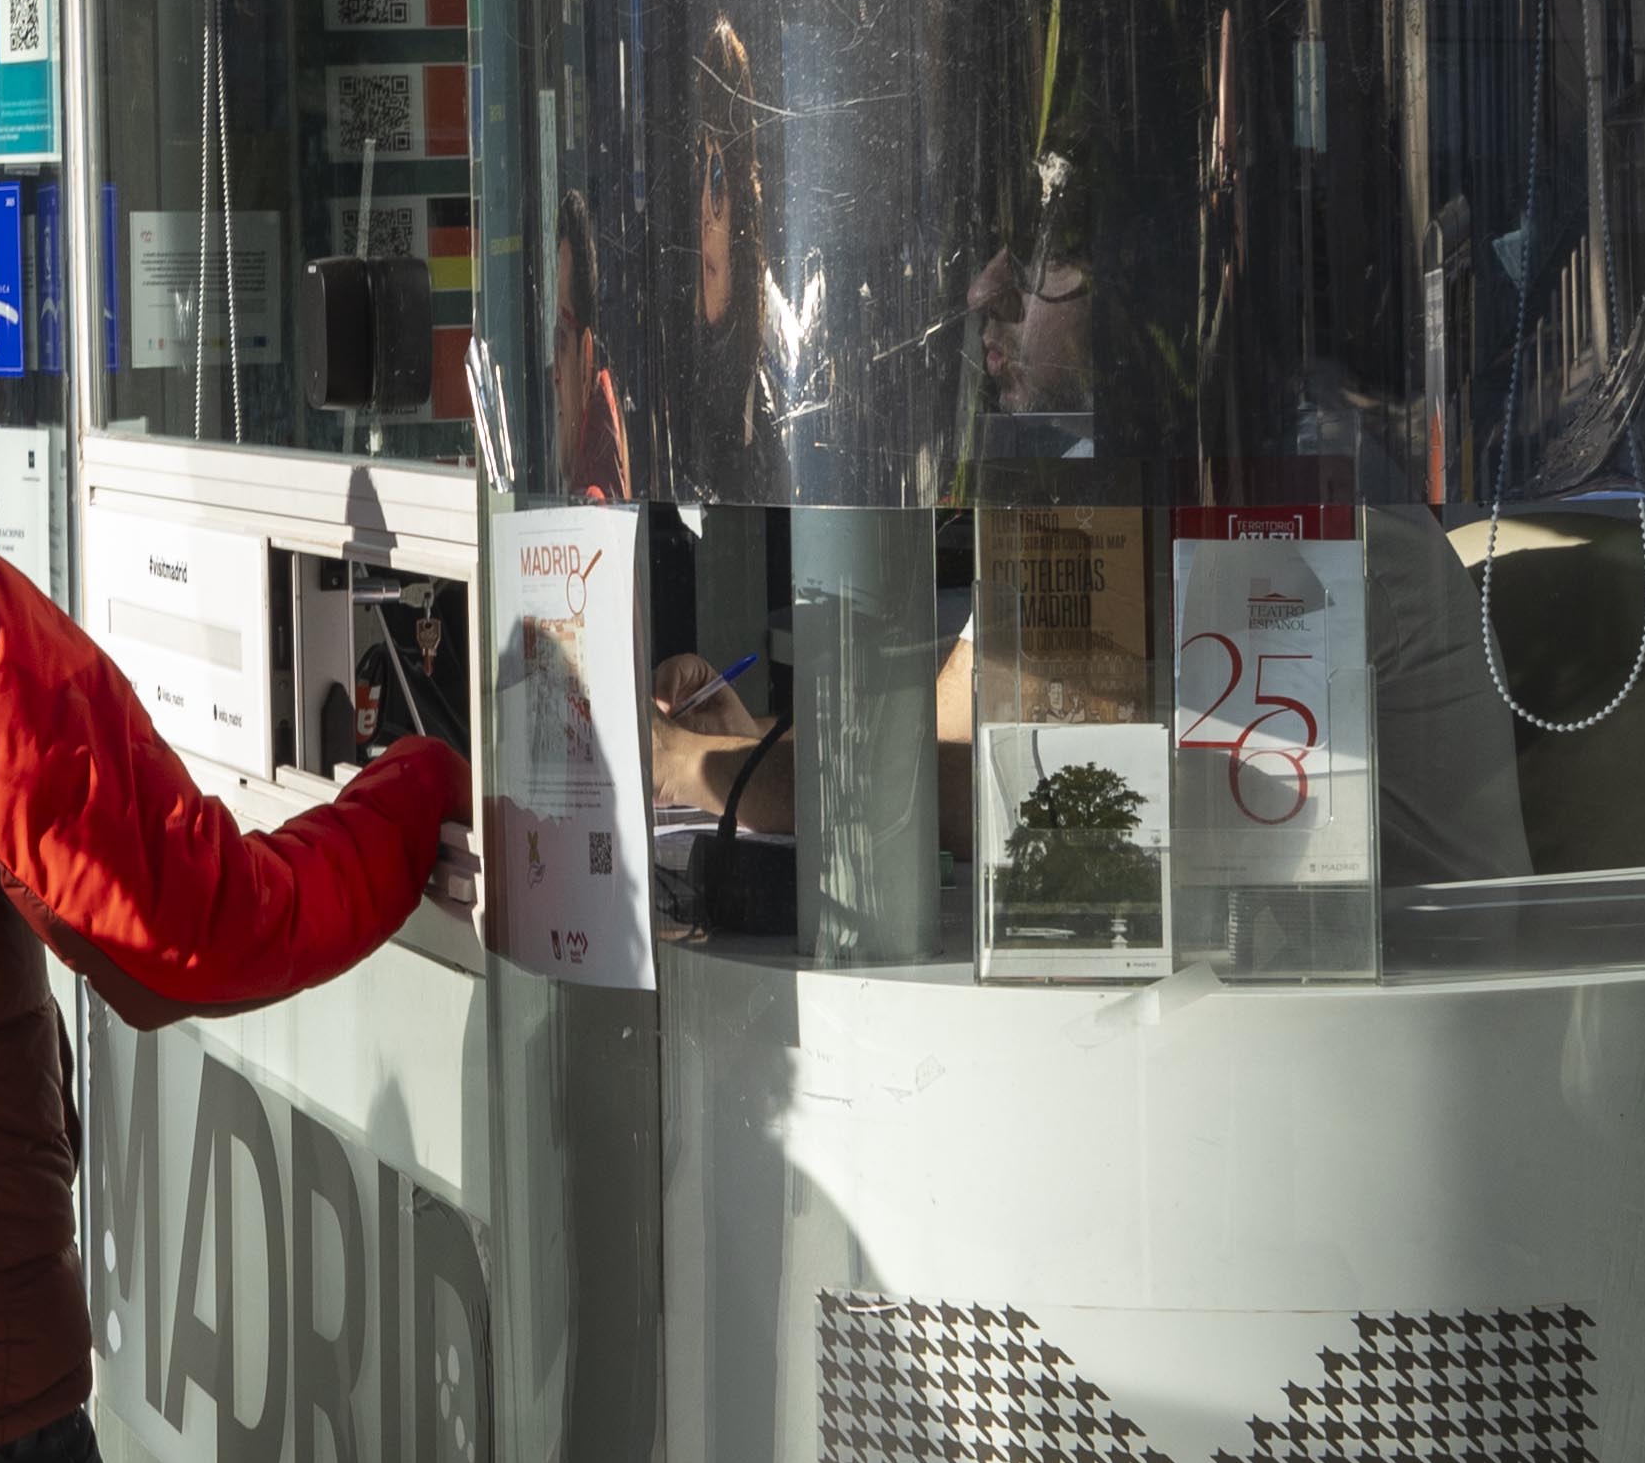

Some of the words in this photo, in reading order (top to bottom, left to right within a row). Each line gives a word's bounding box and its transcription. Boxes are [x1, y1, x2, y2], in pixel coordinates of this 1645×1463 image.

[1237, 520, 1295, 531] TERRITORIO
[520, 545, 581, 578] MADRID
[1020, 595, 1091, 628] MADRID
[1247, 604, 1305, 618] TEATRO
